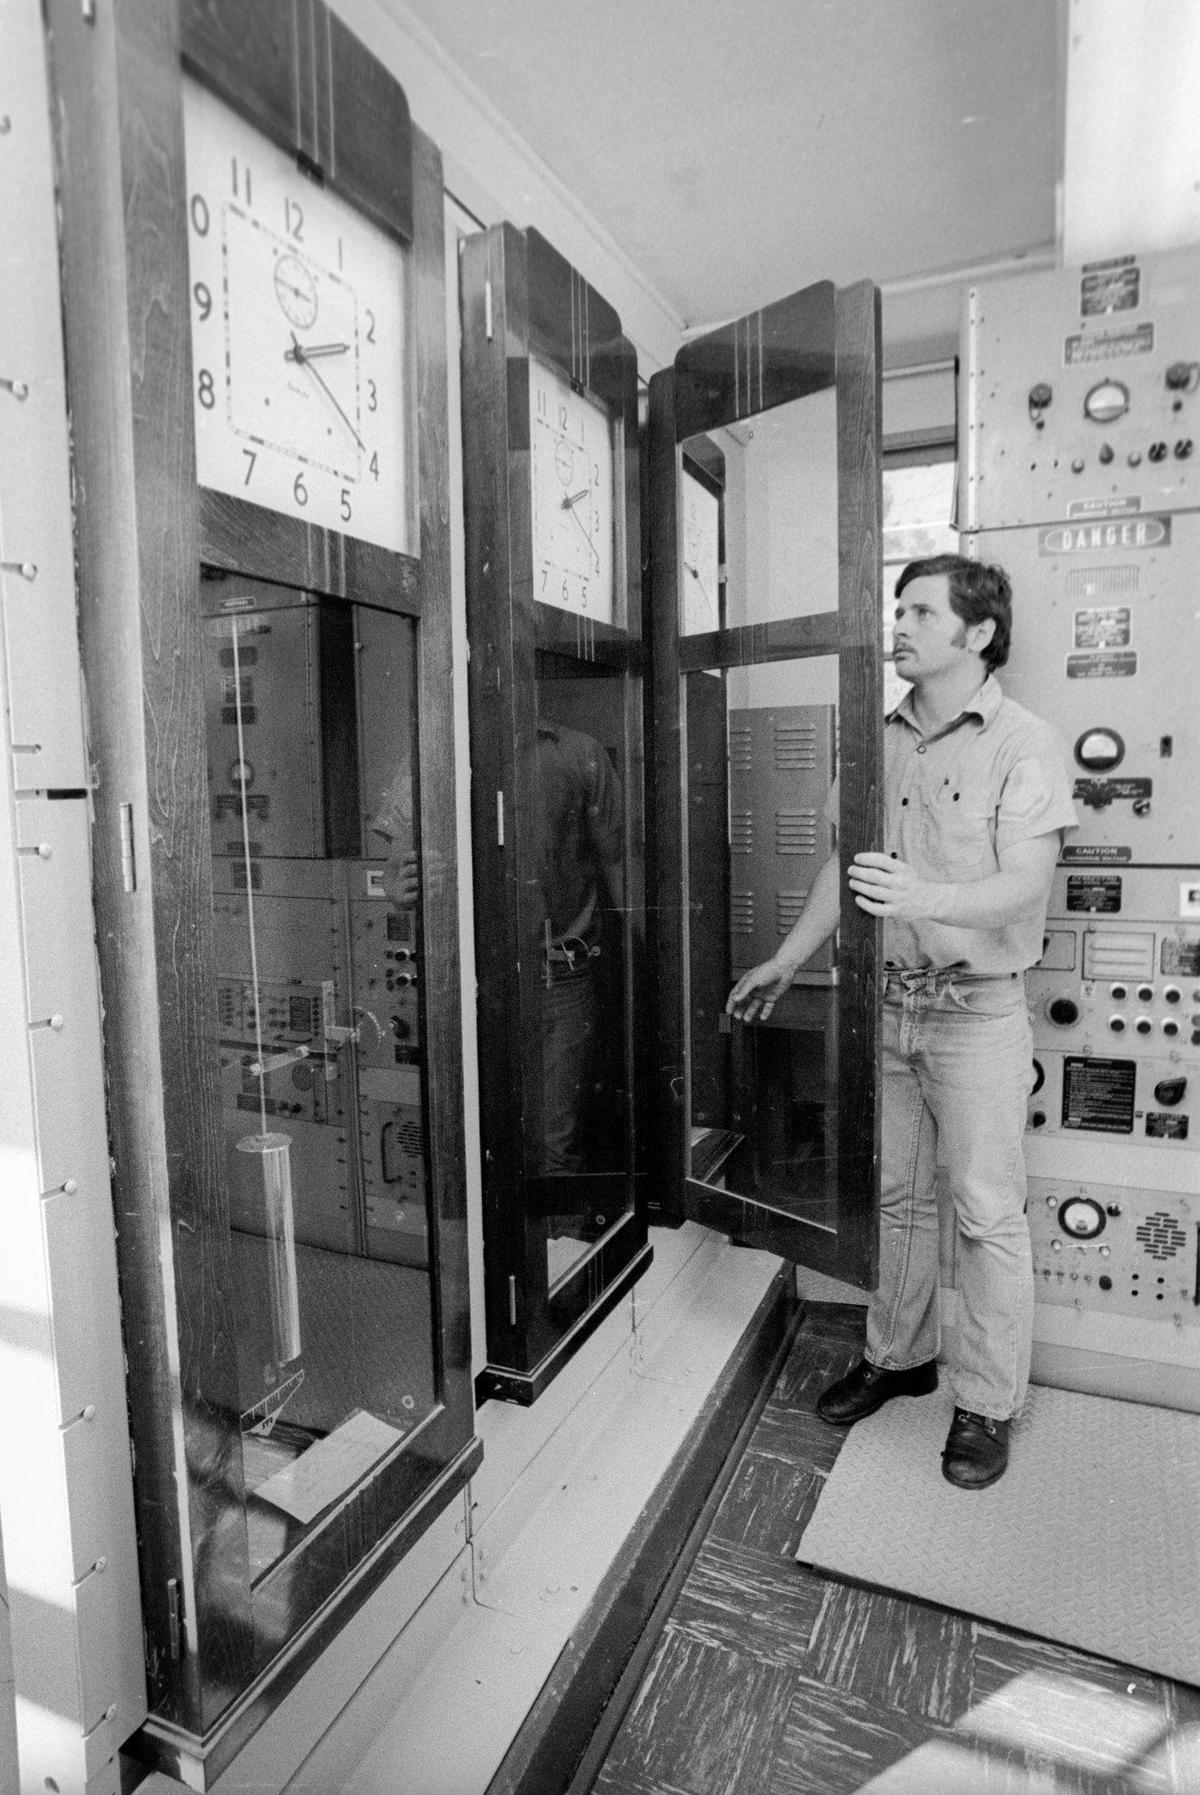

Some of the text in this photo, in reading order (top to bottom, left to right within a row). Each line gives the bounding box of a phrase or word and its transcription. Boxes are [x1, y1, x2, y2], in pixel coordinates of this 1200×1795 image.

[232, 156, 251, 206] 11
[190, 193, 210, 238] 0
[284, 196, 304, 243] 12
[338, 236, 343, 271] 1
[193, 281, 212, 322] 9
[365, 309, 376, 345] 2
[197, 368, 215, 410] 8
[366, 379, 378, 412] 3
[537, 388, 546, 417] 11
[558, 403, 568, 431] 12
[242, 448, 257, 486] 7
[368, 450, 380, 482] 4
[593, 463, 600, 487] 2
[292, 471, 309, 507] 6
[340, 488, 353, 523] 5
[1061, 522, 1147, 550] DANGER
[541, 569, 548, 595] 7
[562, 578, 569, 602] 6
[1075, 847, 1118, 856] CAUTION
